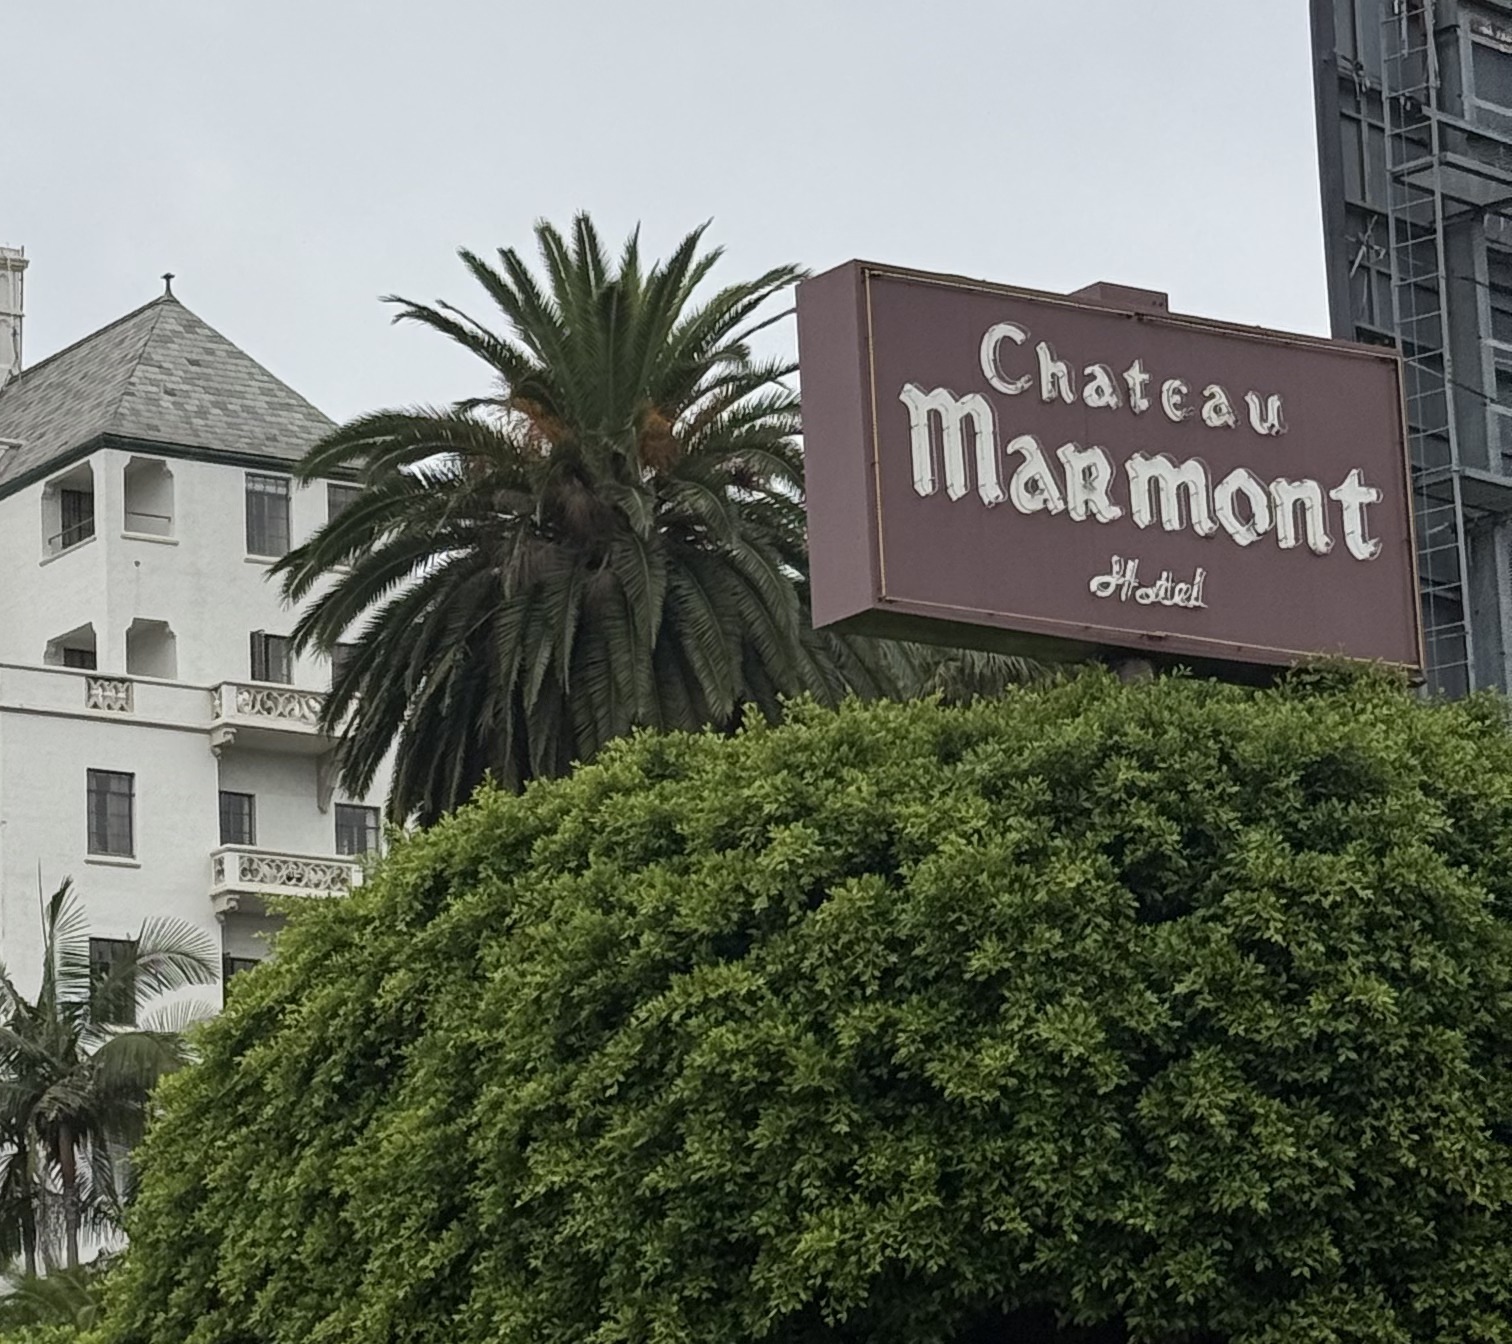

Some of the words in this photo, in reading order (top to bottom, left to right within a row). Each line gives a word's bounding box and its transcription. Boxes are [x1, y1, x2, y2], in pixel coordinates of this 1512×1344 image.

[979, 321, 1286, 437] Chateau
[899, 382, 1383, 561] Marmont
[1089, 555, 1208, 609] Hotel
